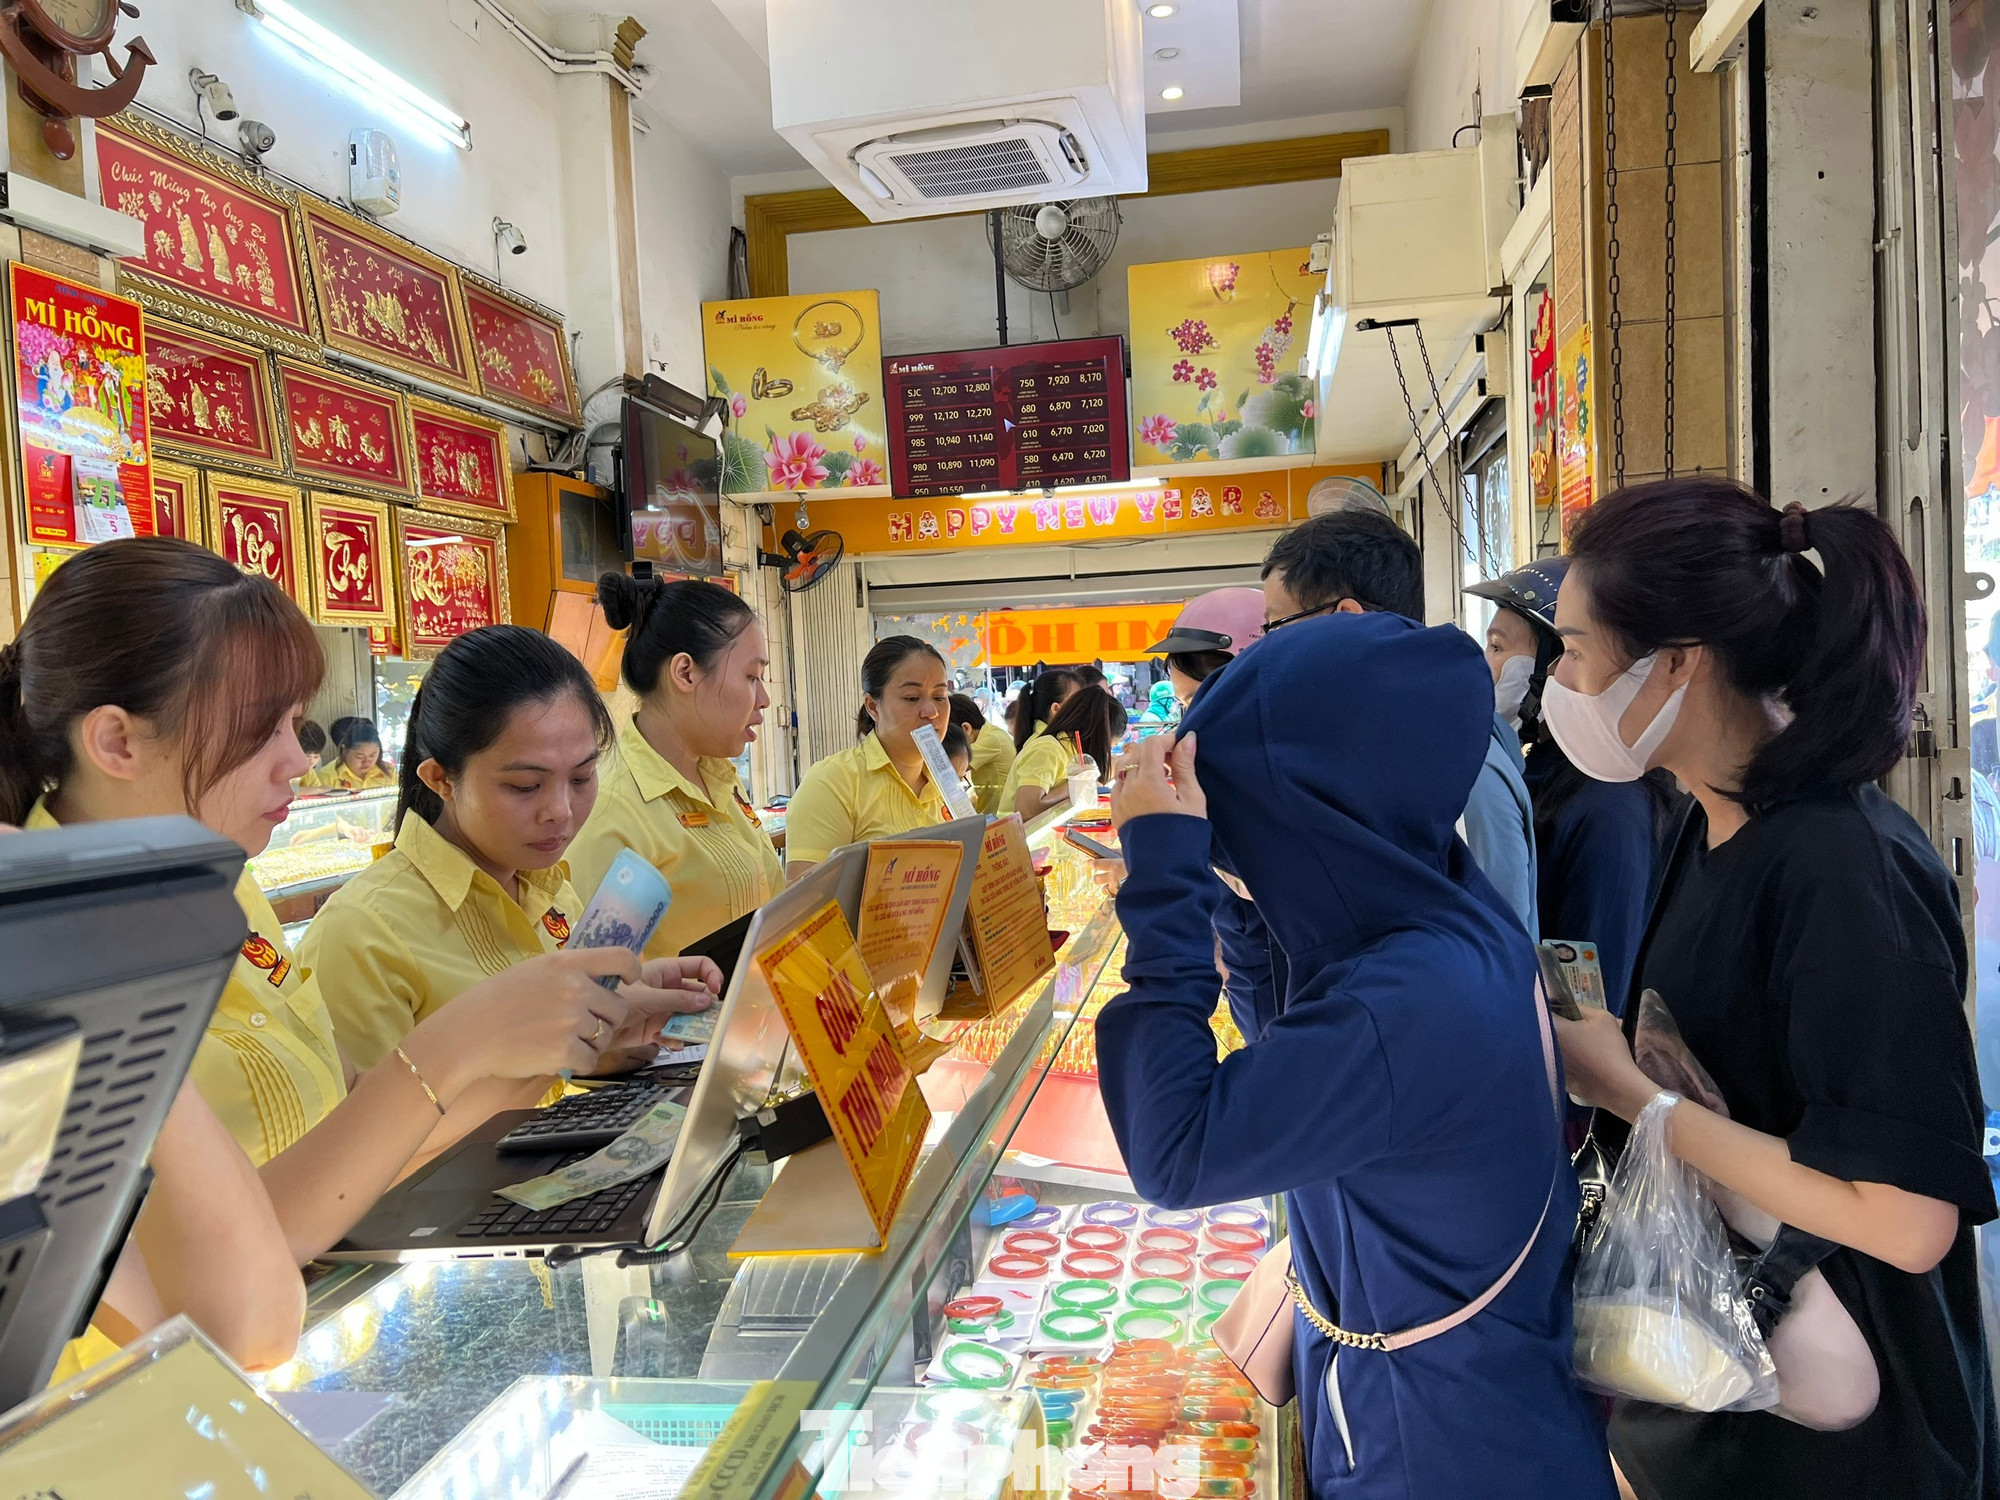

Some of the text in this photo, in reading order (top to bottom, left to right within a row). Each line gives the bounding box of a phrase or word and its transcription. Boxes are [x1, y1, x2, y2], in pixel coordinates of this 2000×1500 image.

[111, 161, 144, 183] Chúc
[223, 202, 244, 231] Ông
[251, 223, 267, 244] Bà
[1020, 373, 1101, 388] 750 7,920 8,170
[907, 383, 990, 397] SJC 12,700 12,800
[1021, 399, 1103, 413] 680 6,870 7,120
[909, 409, 992, 422] 999 12,120 12,270
[1023, 425, 1104, 438] 610 6,770 7,020
[911, 433, 993, 447] 985 10,940 11,140
[1024, 450, 1105, 464] 580 6,470 6,720
[913, 458, 995, 472] 980 10,890 11,090
[87, 477, 116, 511] 27
[888, 485, 1245, 543] HAPPY NEW YEAR
[110, 520, 118, 533] 5
[839, 1069, 884, 1159] THU
[706, 1448, 750, 1492] CCCD
